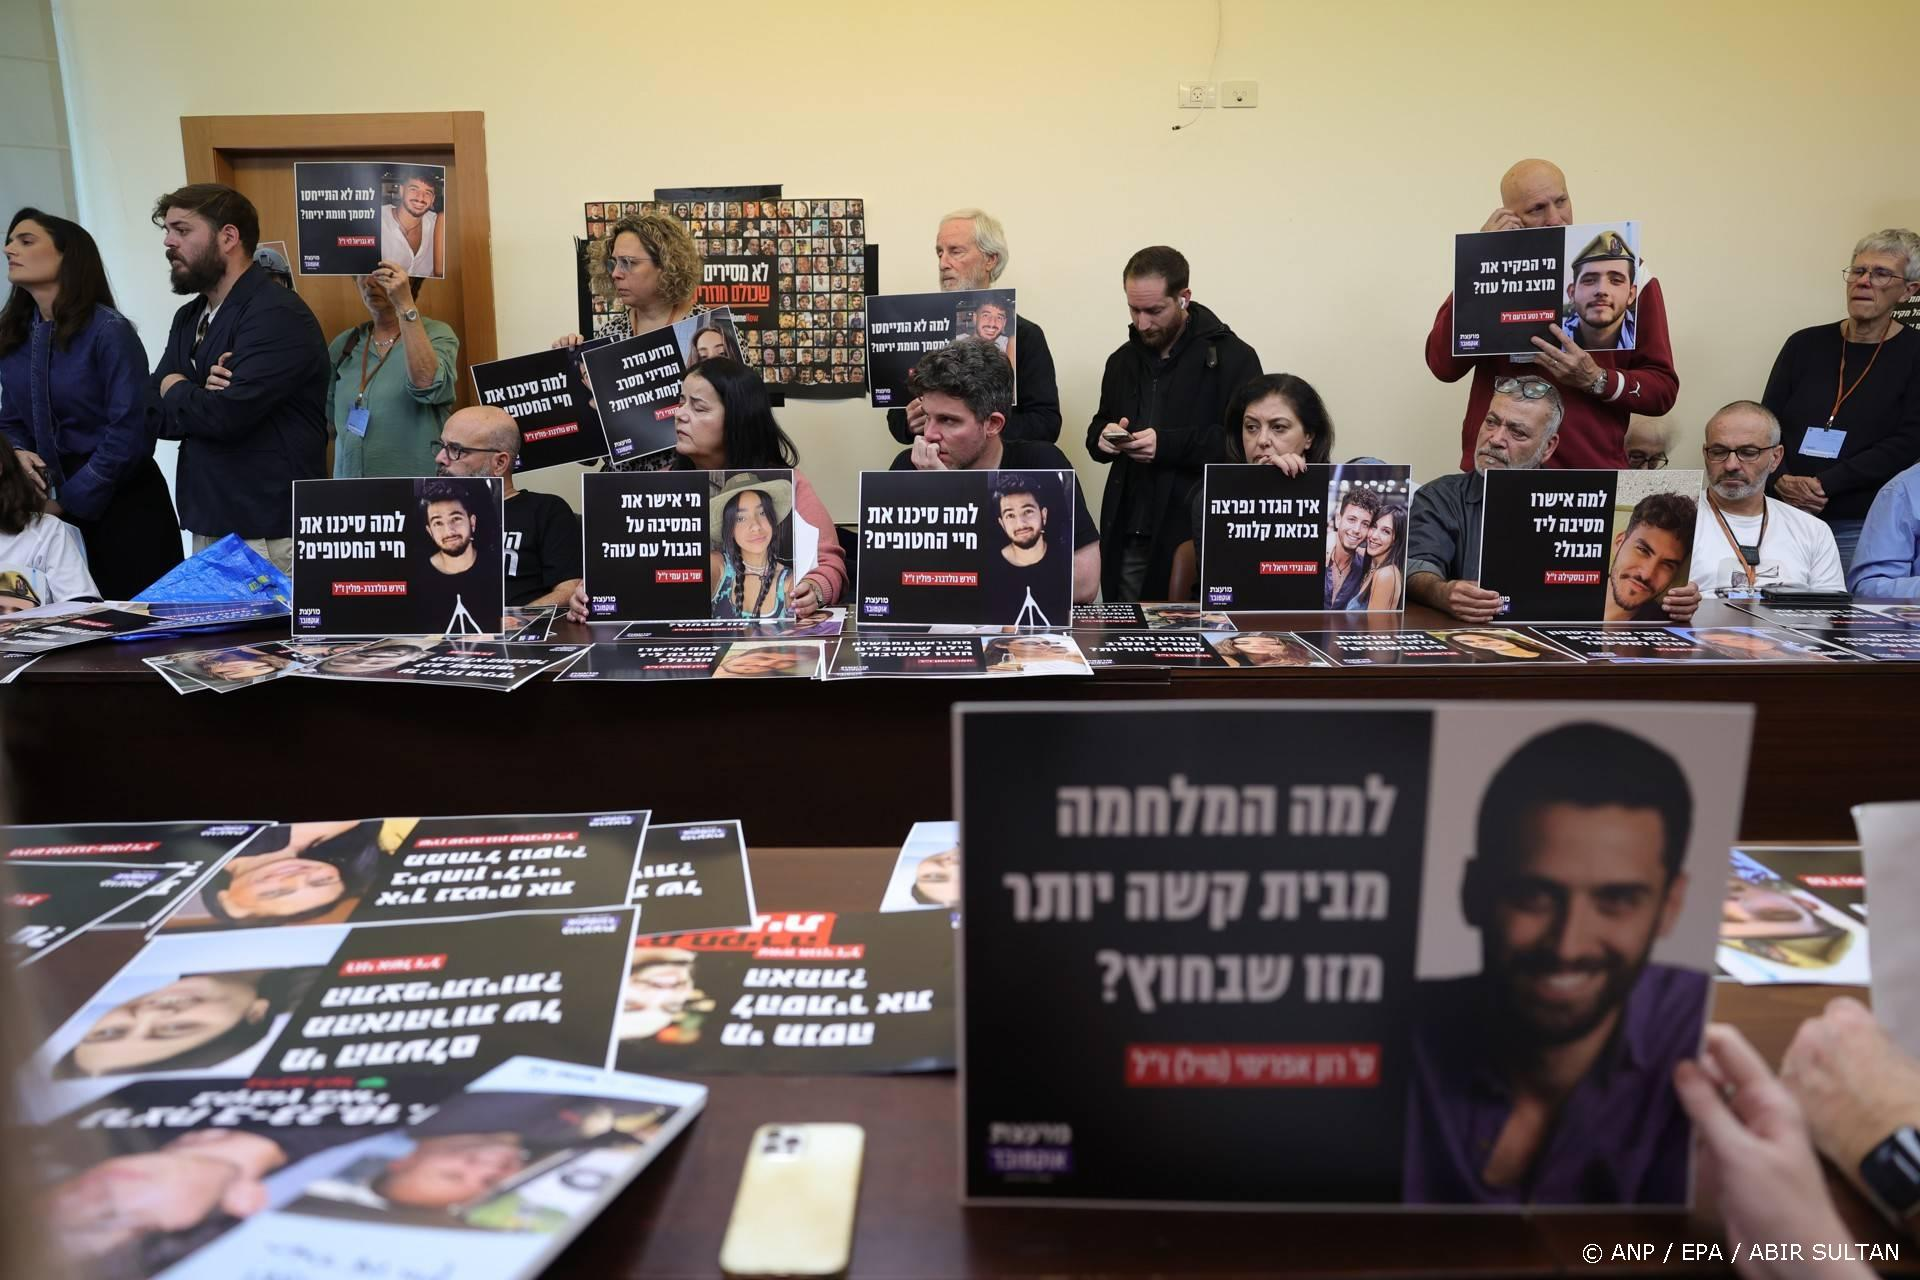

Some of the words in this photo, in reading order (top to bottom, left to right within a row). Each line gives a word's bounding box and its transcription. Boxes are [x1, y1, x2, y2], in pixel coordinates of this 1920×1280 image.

[300, 190, 339, 201] התייחסו
[340, 187, 353, 201] לא
[355, 187, 376, 201] למה
[300, 209, 324, 220] יריחו?
[325, 210, 346, 220] חומת
[348, 208, 376, 221] למסמך
[752, 262, 769, 282] לא
[1480, 261, 1499, 274] את
[1502, 259, 1539, 275] הפקיר
[1542, 258, 1556, 270] מי
[704, 264, 748, 282] מסירים
[1474, 281, 1499, 295] עוז?
[1502, 278, 1522, 294] נחל
[1525, 278, 1556, 292] מוצב
[731, 284, 770, 303] שכולם
[871, 321, 912, 334] התייחסו
[914, 318, 927, 332] לא
[929, 318, 950, 332] למה
[649, 344, 675, 362] מדוע
[871, 342, 896, 353] יריחו?
[897, 342, 920, 352] חומת
[621, 351, 648, 370] הדרג
[645, 362, 680, 382] המדיני
[506, 378, 538, 398] סיכנו
[541, 372, 568, 391] למה
[616, 371, 645, 392] מסרב
[484, 388, 505, 404] את
[655, 380, 684, 402] לקחת
[552, 393, 573, 408] חיי
[608, 389, 654, 414] אחריות?
[621, 494, 642, 509] את
[646, 493, 682, 508] אישר
[685, 493, 701, 507] מי
[1211, 500, 1255, 514] נפרצה
[1258, 500, 1292, 514] הגדר
[1530, 493, 1574, 508] אישרו
[1578, 490, 1608, 508] למה
[868, 506, 893, 524] את
[898, 506, 939, 524] סיכנו
[944, 503, 978, 524] למה
[1298, 500, 1320, 518] איך
[300, 516, 323, 534] את
[326, 514, 366, 534] סיכנו
[370, 511, 406, 532] למה
[626, 516, 645, 533] על
[648, 517, 701, 532] המסיבה
[1534, 516, 1556, 533] ליד
[1559, 518, 1605, 533] מסיבה
[1226, 522, 1271, 541] קלות?
[1274, 522, 1319, 538] בכזאת
[865, 530, 948, 550] החטופים?
[952, 532, 978, 549] חיי
[298, 541, 376, 560] החטופים?
[381, 540, 406, 558] חיי
[602, 542, 636, 558] עזה?
[639, 543, 658, 558] עם
[662, 540, 702, 557] הגבול
[1554, 540, 1603, 558] הגבול?
[689, 571, 701, 580] שני
[1261, 563, 1272, 572] ז"ל
[1272, 563, 1288, 572] חיאל
[1289, 563, 1306, 572] וגידי
[1306, 563, 1318, 572] נעה
[657, 571, 668, 581] ז"ל
[670, 572, 681, 580] עמי
[680, 572, 689, 582] בן
[904, 574, 916, 584] ז"ל
[916, 574, 959, 585] גולדברג-פולין
[960, 575, 976, 584] הירש
[1546, 572, 1556, 582] ז"ל
[1557, 572, 1584, 582] בוסקילה
[1584, 573, 1599, 583] ירדן
[334, 584, 344, 593] ז"ל
[344, 583, 388, 594] גולדברג-פולין
[388, 584, 406, 593] הירש
[592, 604, 615, 612] אוקטובר
[865, 596, 889, 604] מועצת
[865, 605, 888, 613] אוקטובר
[299, 617, 320, 625] אוקטובר
[1056, 774, 1278, 838] המלחמה
[1289, 774, 1398, 837] למה
[402, 849, 502, 868] ממחדל
[510, 844, 588, 864] נוסף?
[391, 868, 488, 888] ביטחון
[493, 864, 563, 882] ילדיי
[374, 889, 421, 907] איך
[430, 884, 522, 904] נבטיח
[528, 880, 576, 898] את
[655, 879, 702, 898] של
[1258, 871, 1390, 921] מבית
[1002, 871, 1115, 923] יותר
[1125, 871, 1250, 931] קשה
[742, 967, 868, 989] האמת?
[1096, 950, 1292, 1014] שבחוץ?
[1305, 954, 1384, 1002] מזו
[320, 971, 564, 1008] התצפיתניות?
[731, 992, 869, 1018] להסתיר
[876, 989, 934, 1015] את
[302, 1003, 500, 1038] מהאזהרות
[503, 998, 564, 1024] של
[720, 1024, 766, 1046] מי
[772, 1022, 876, 1046] מנסה
[280, 1047, 328, 1072] מי
[334, 1034, 481, 1069] התעלם
